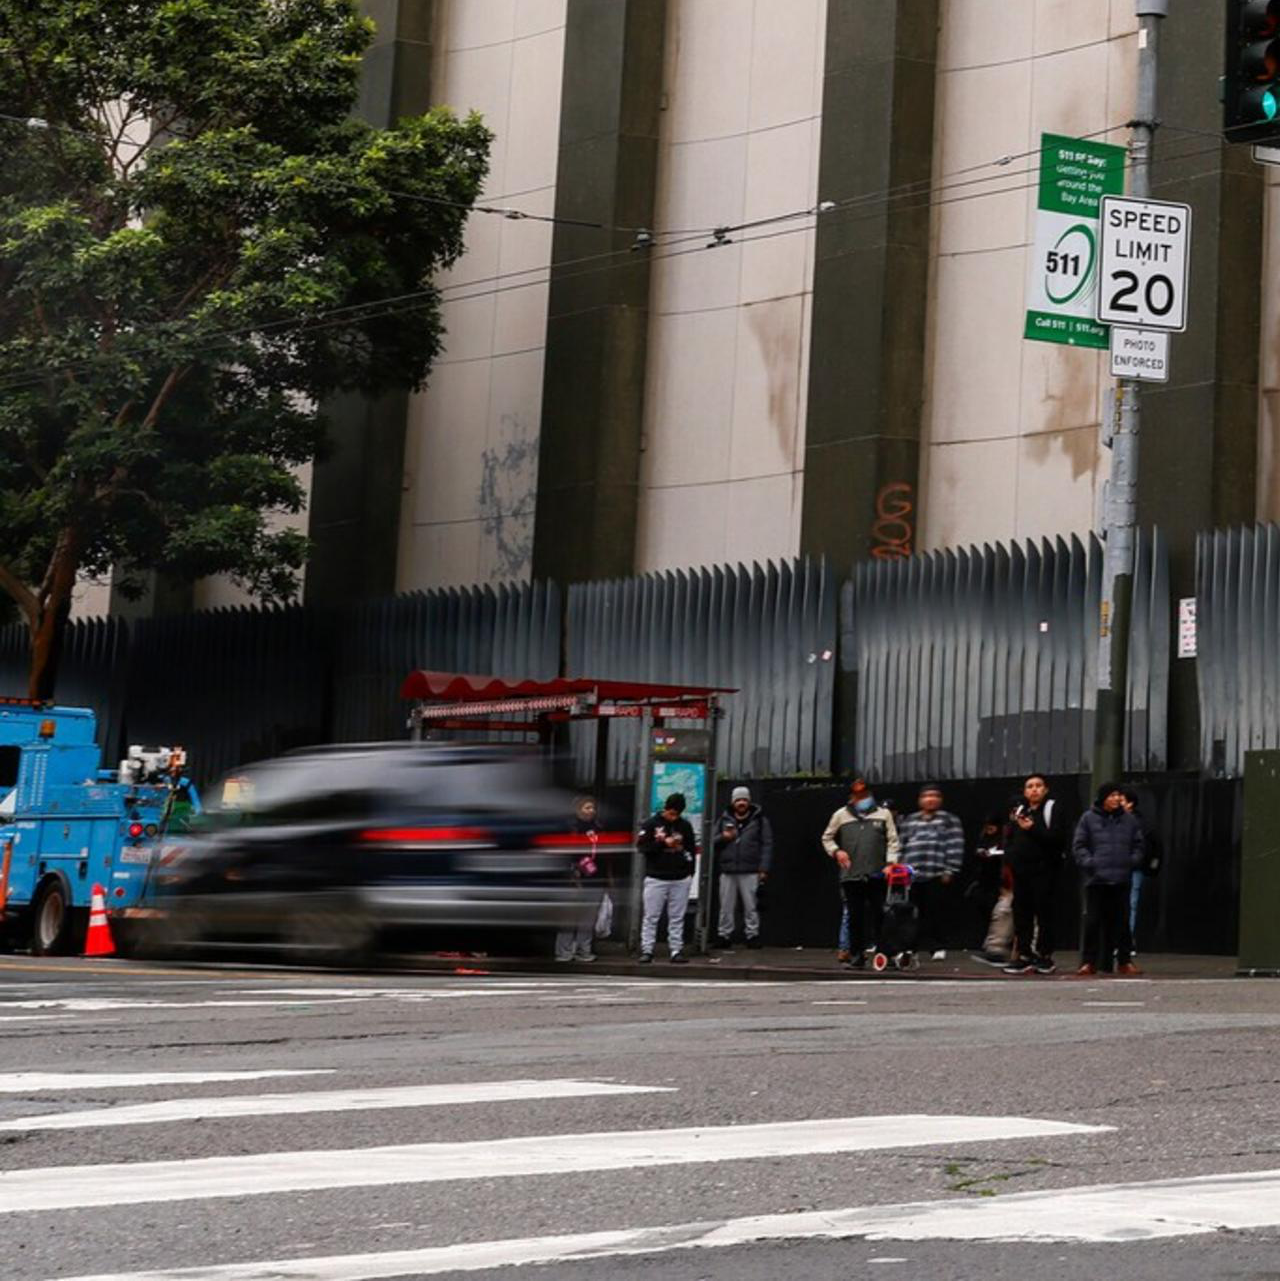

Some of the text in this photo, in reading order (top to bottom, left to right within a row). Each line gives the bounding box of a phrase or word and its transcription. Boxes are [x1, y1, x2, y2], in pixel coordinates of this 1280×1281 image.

[1110, 209, 1181, 235] SPEED
[1045, 250, 1080, 276] 511
[1115, 239, 1172, 263] LIMIT
[1109, 270, 1174, 317] 20
[1035, 317, 1051, 327] Call
[1123, 338, 1156, 352] PHOTO
[1114, 355, 1165, 371] ENFORCED
